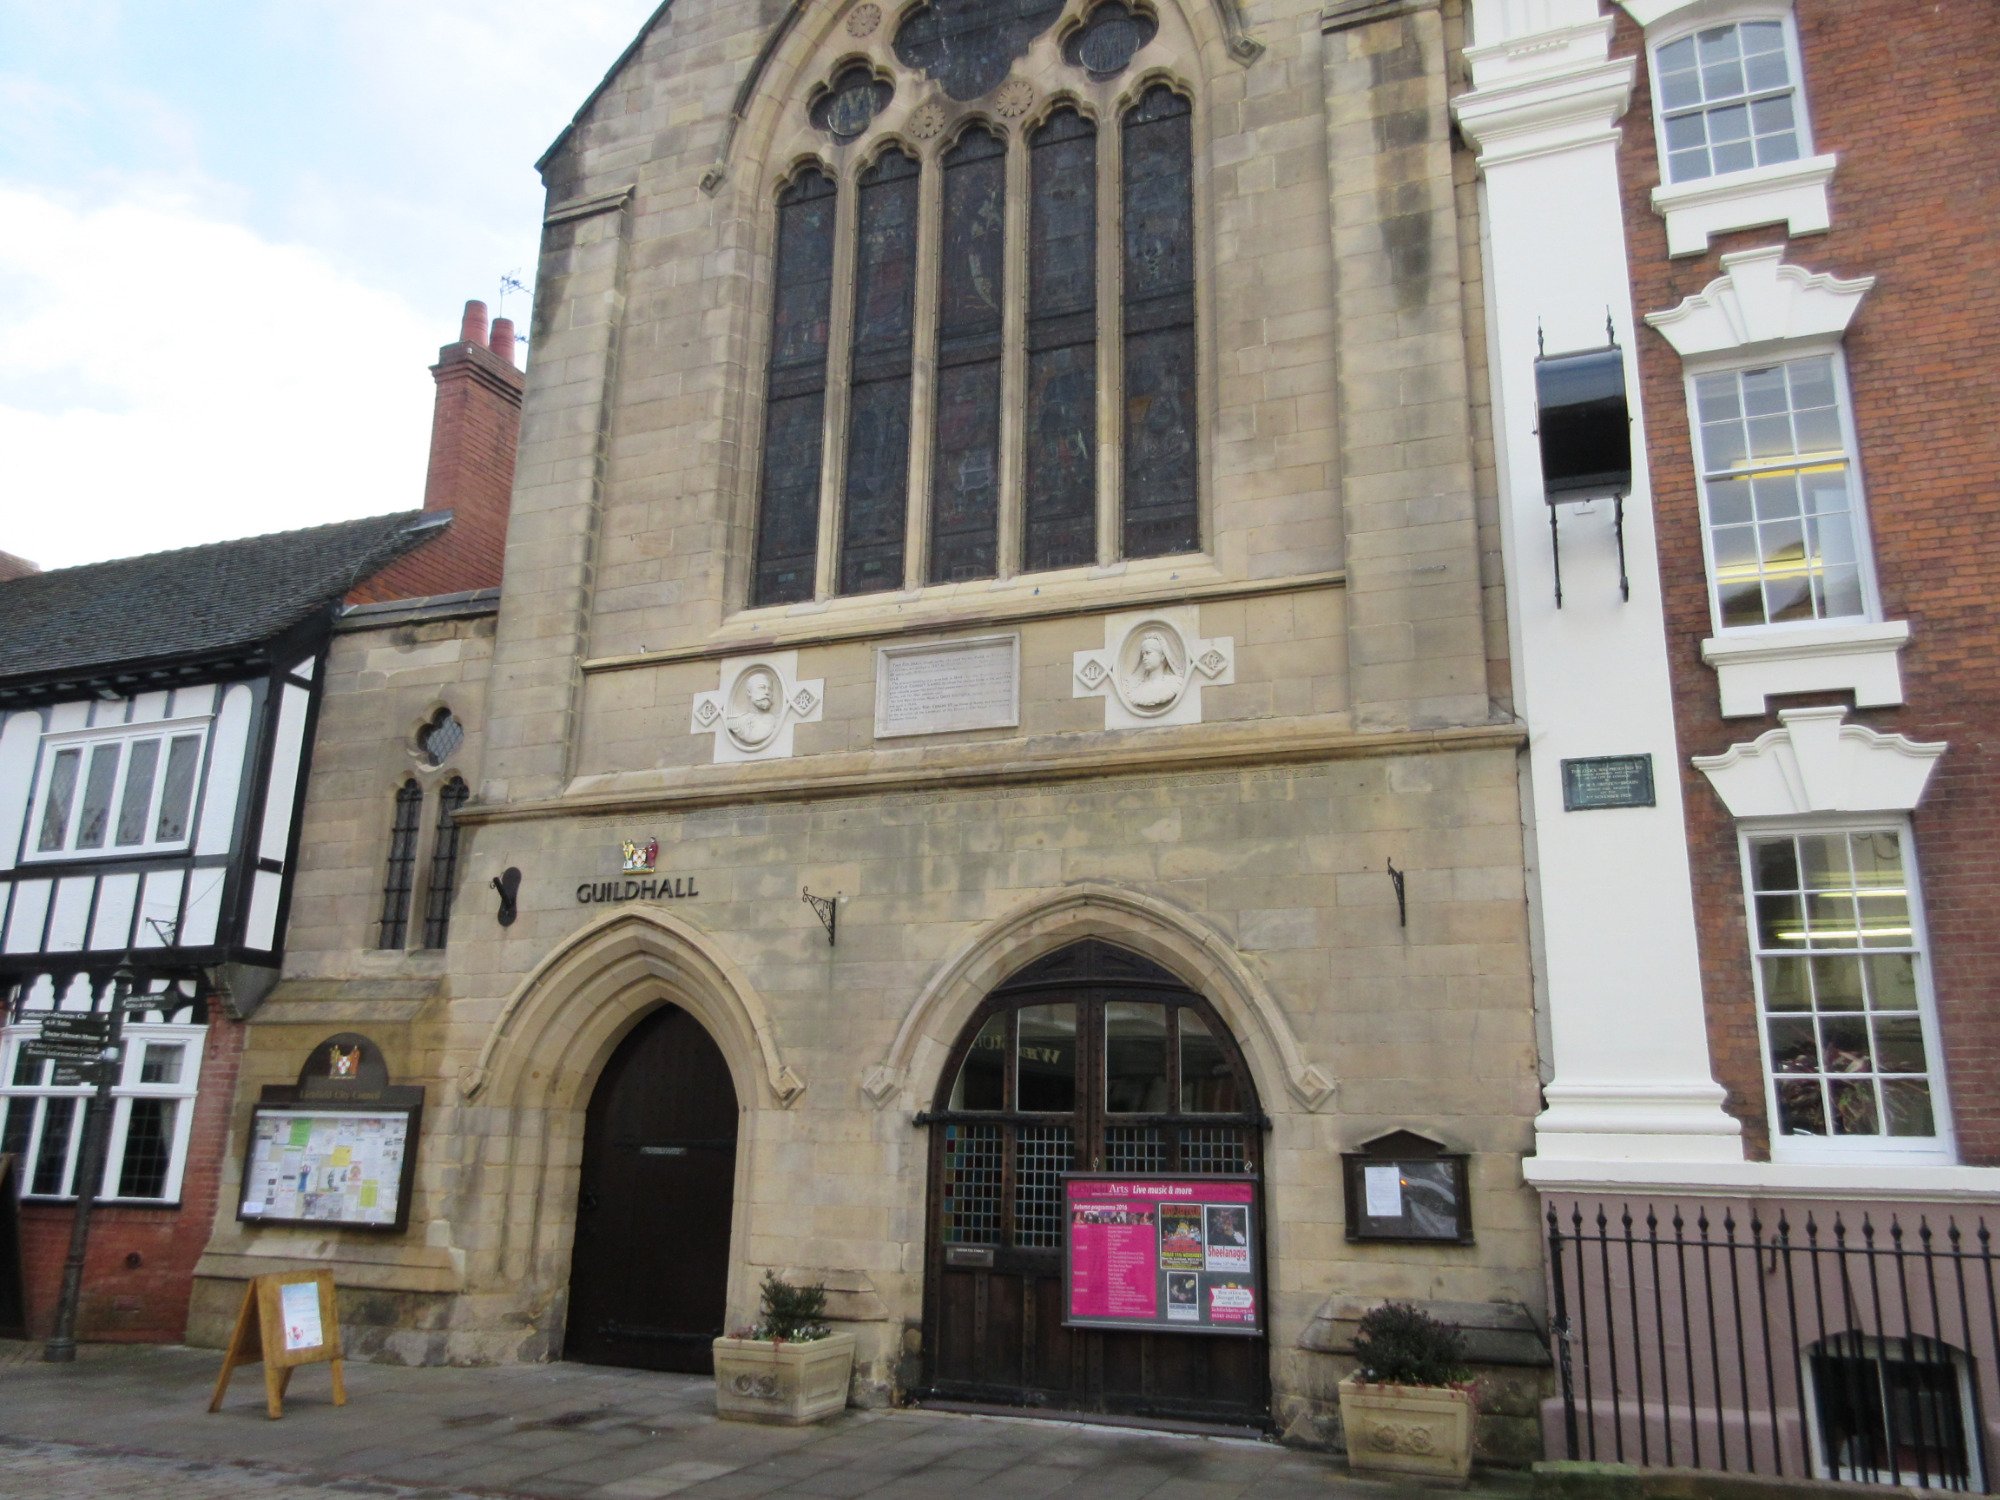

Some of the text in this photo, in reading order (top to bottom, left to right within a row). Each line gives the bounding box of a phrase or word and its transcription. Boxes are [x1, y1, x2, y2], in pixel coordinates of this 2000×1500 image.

[577, 877, 699, 904] GUILDHALL
[1109, 1184, 1129, 1194] Arts
[1132, 1185, 1146, 1195] Live
[1148, 1186, 1167, 1195] music
[1168, 1186, 1174, 1195] &
[1175, 1187, 1192, 1195] more
[1208, 1246, 1247, 1261] Sheelanagig
